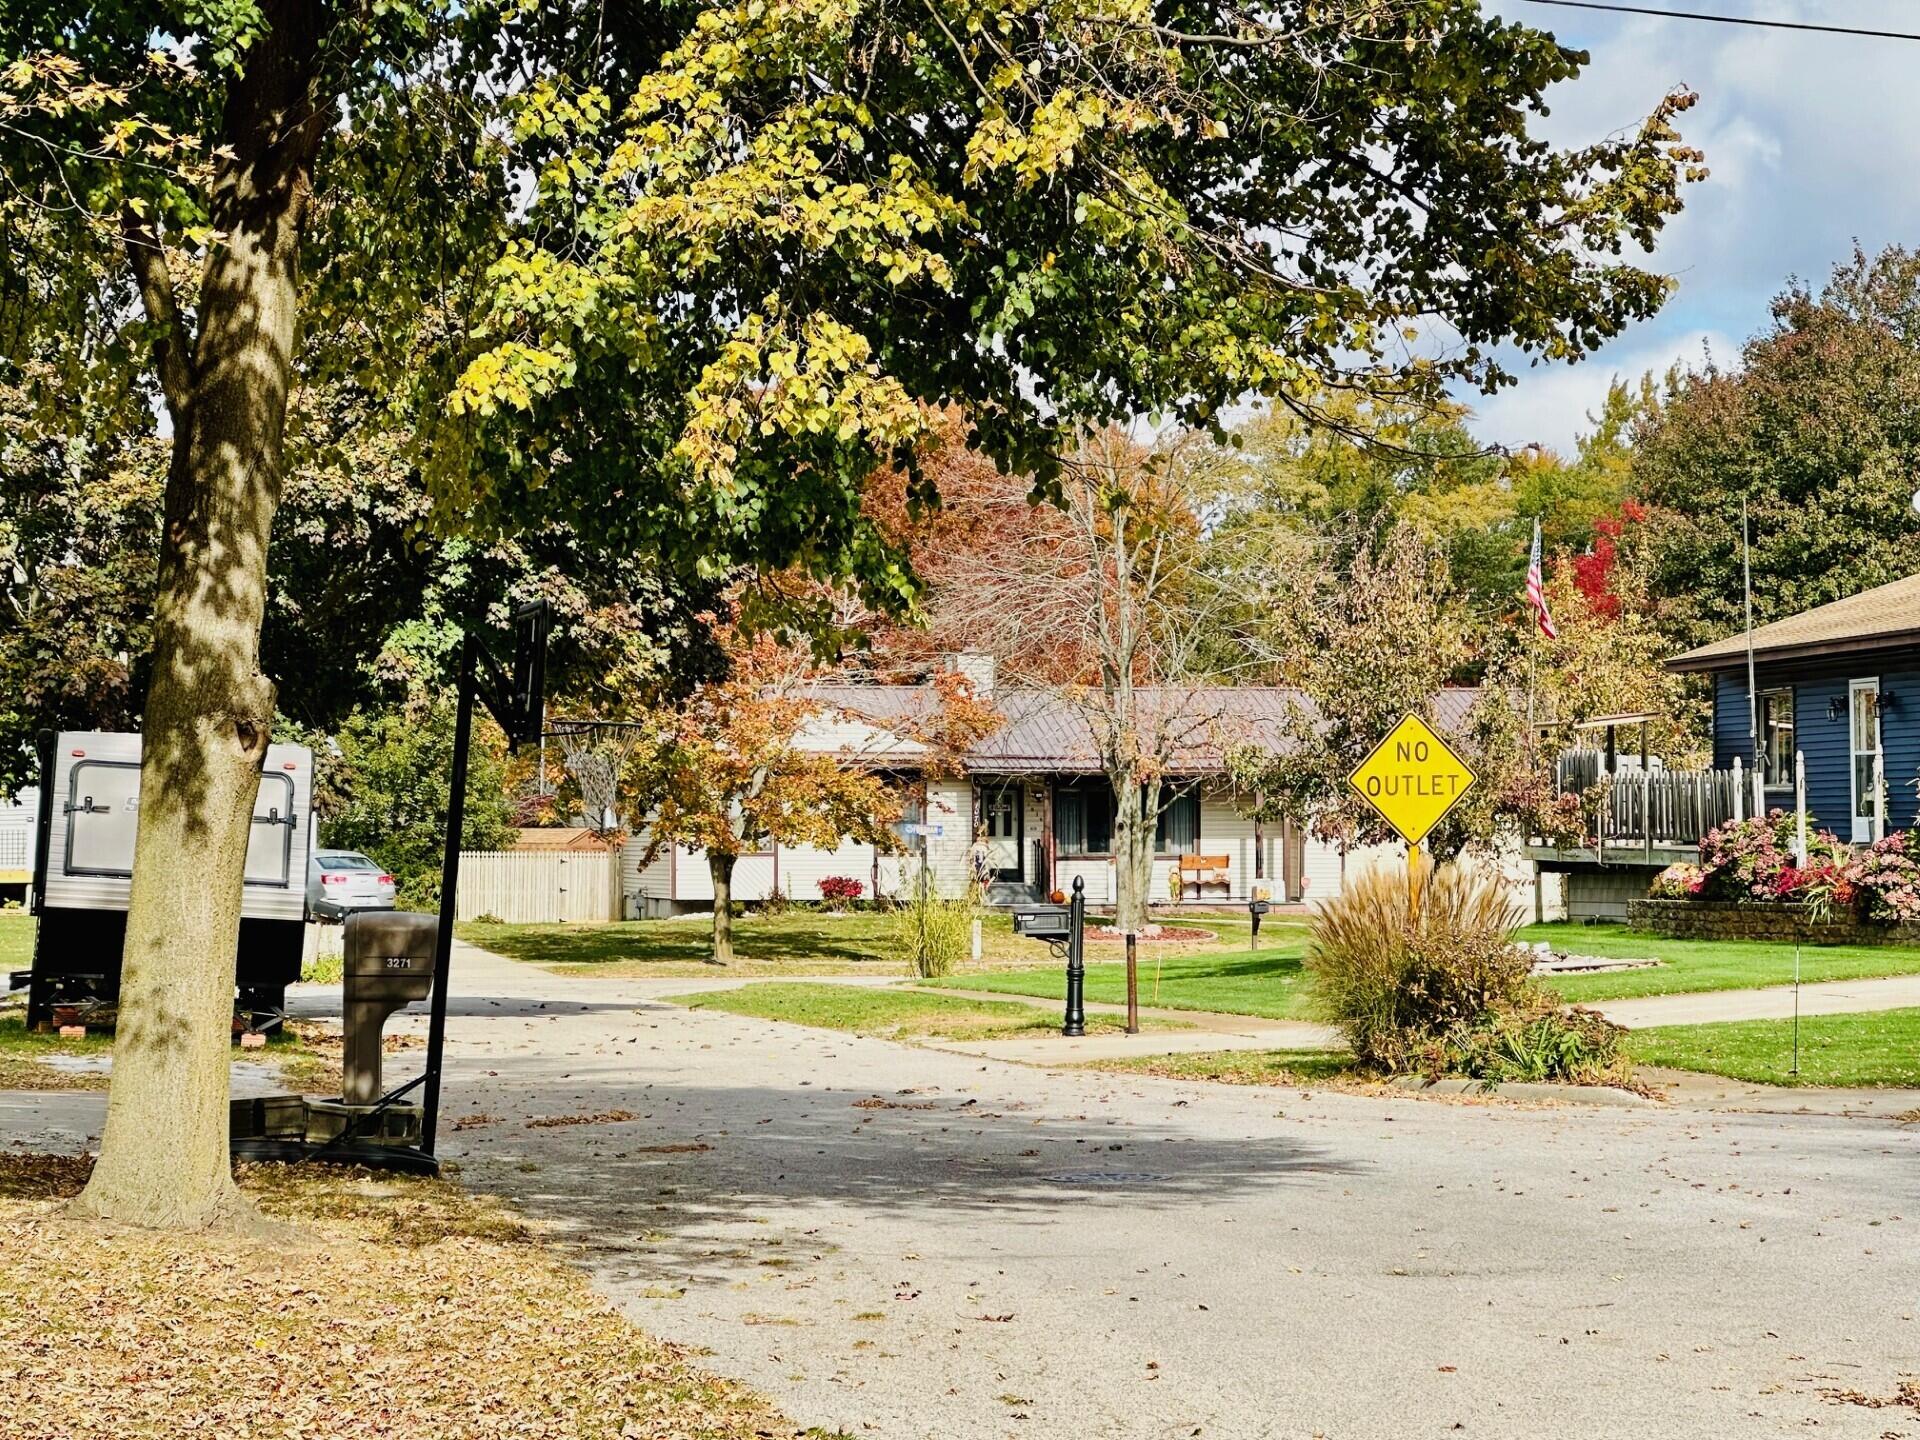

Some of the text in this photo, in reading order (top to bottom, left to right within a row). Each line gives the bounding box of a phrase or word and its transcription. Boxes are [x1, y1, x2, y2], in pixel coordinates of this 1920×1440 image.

[1396, 741, 1429, 762] NO
[1366, 774, 1460, 797] OUTLET
[386, 958, 411, 968] 3271
